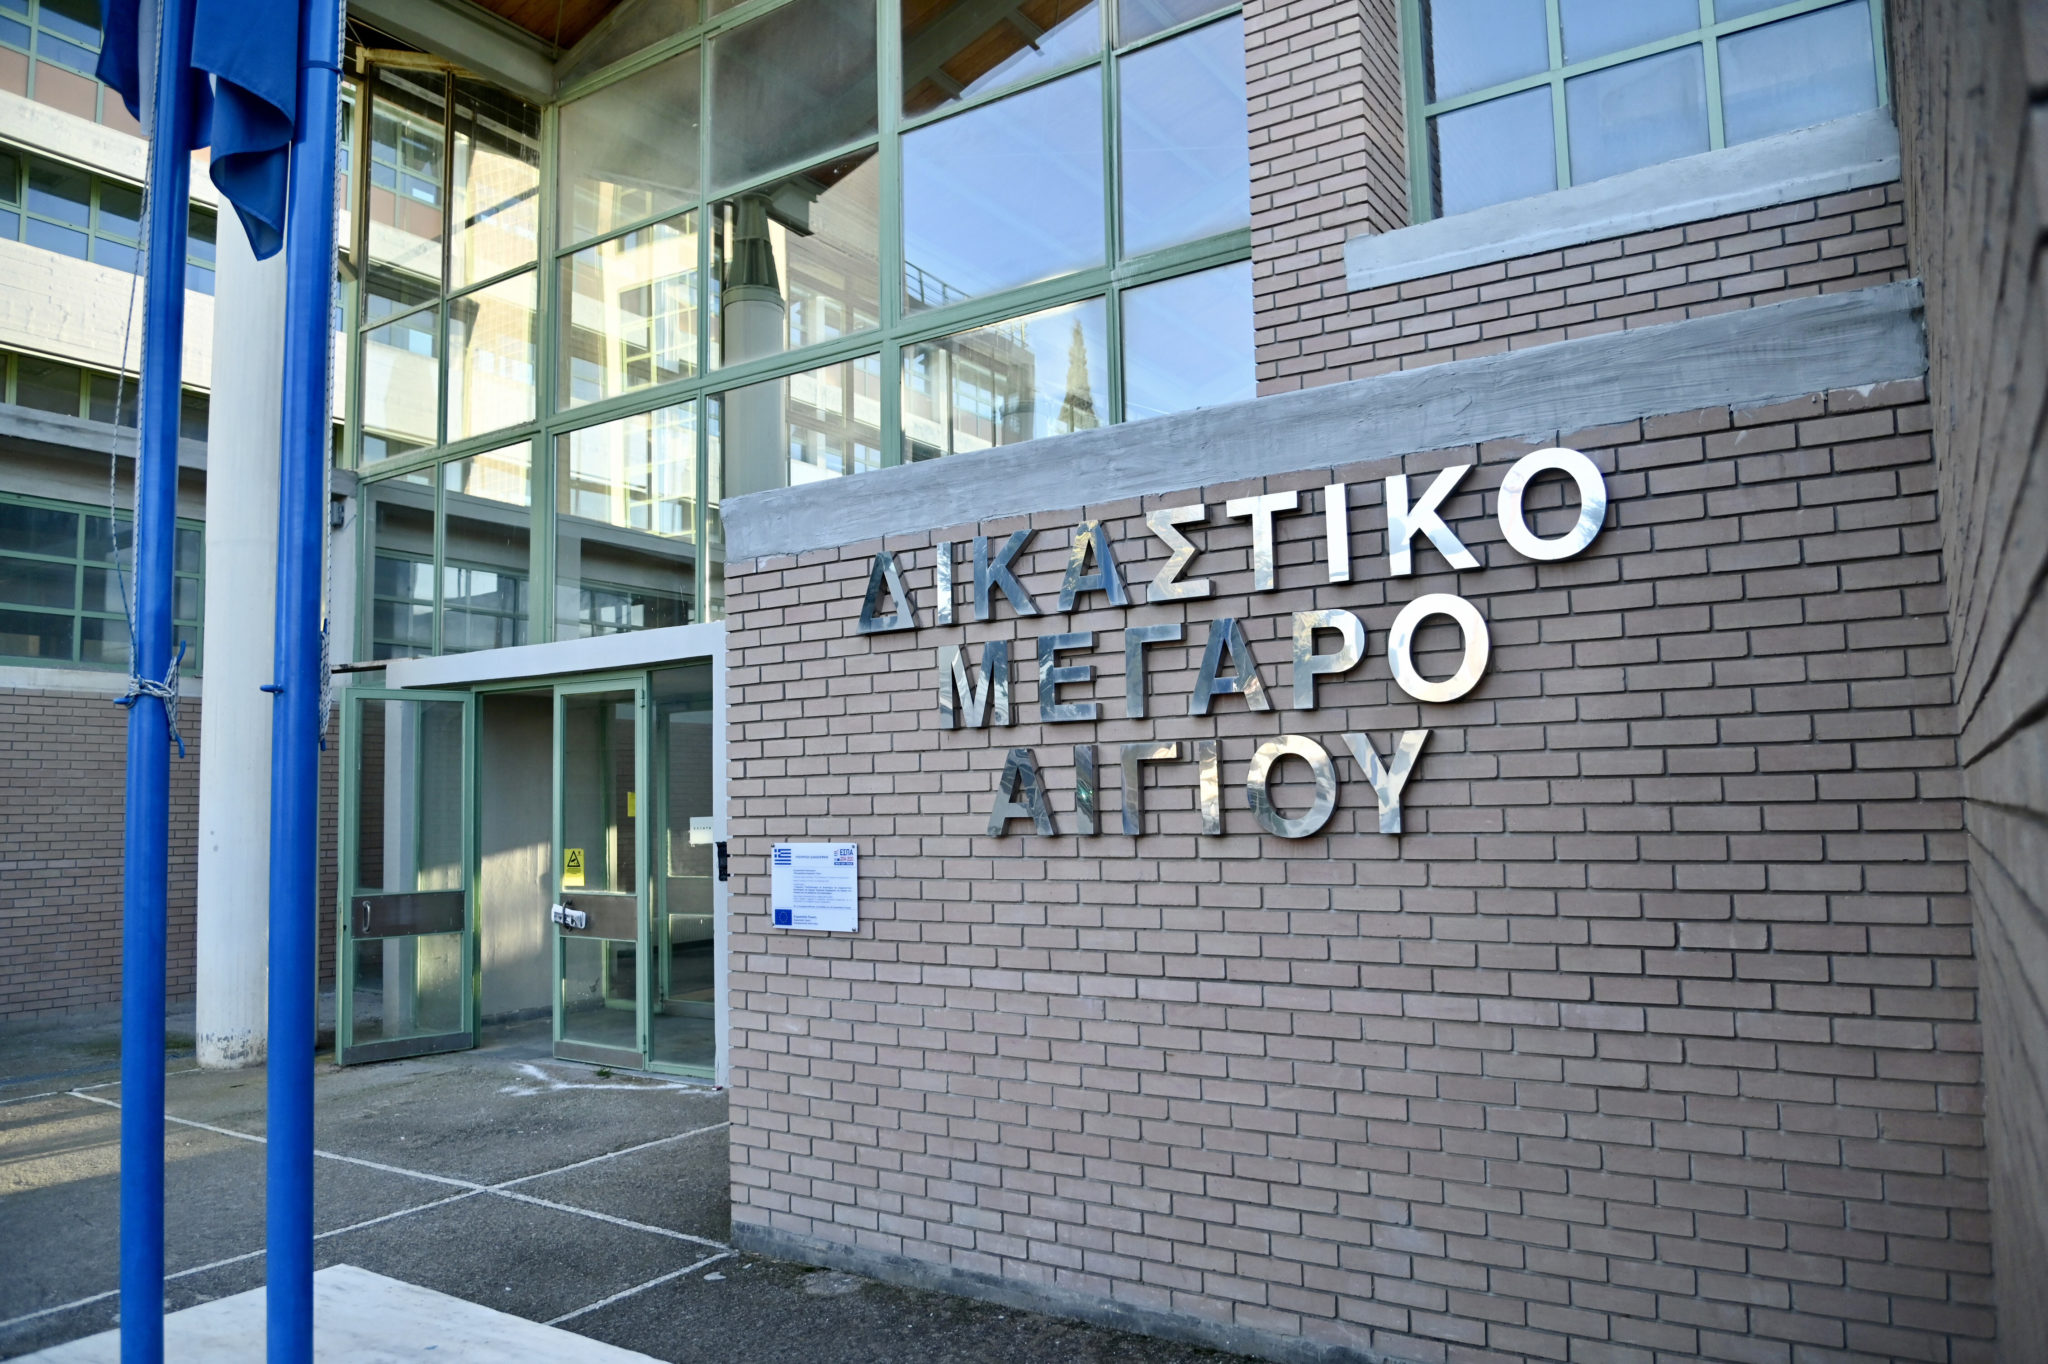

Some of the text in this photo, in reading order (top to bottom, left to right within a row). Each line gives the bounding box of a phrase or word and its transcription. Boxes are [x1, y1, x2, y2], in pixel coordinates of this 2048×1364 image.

[857, 447, 1608, 635] ΔΙΚΑΣΤΙΚΟ
[938, 593, 1491, 730] ΜΕΓΑΡΟ
[987, 729, 1434, 838] ΑΙΓΙΟΥ
